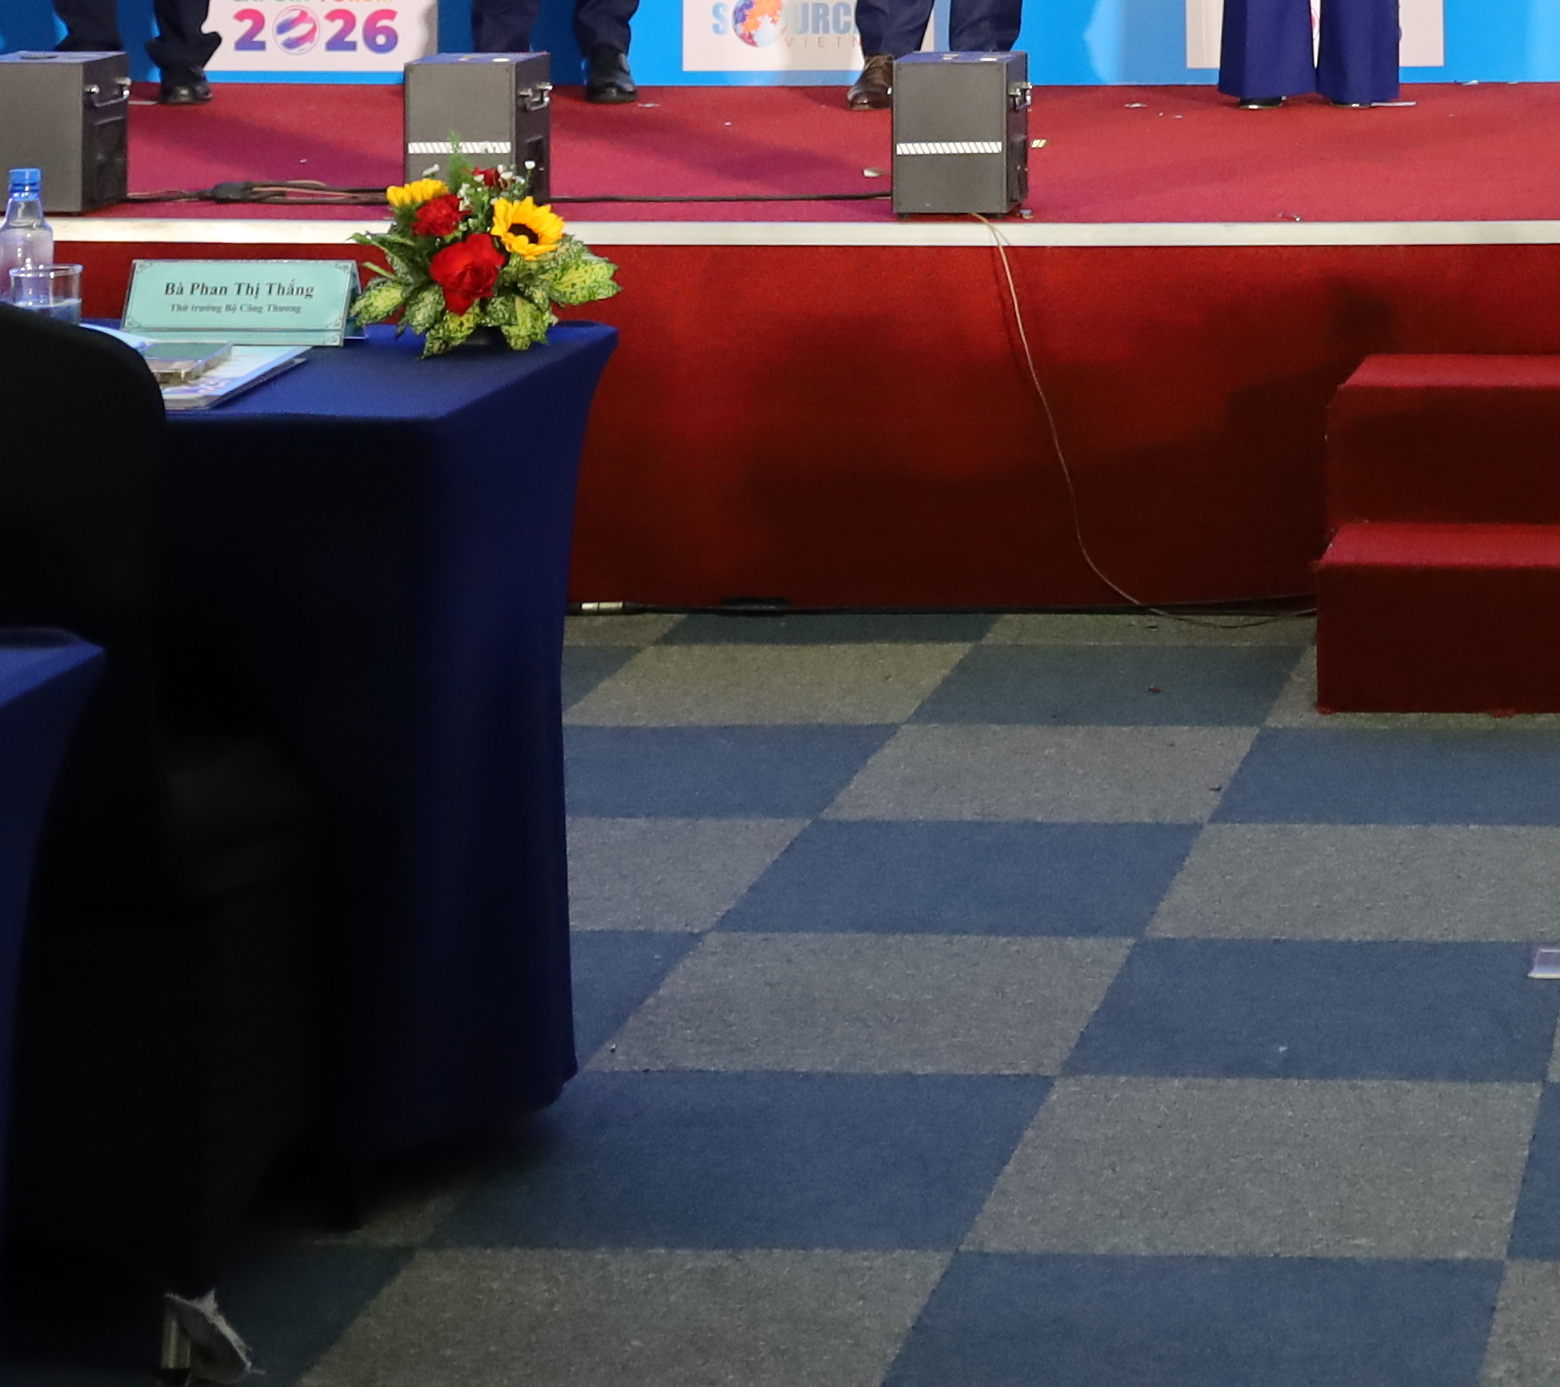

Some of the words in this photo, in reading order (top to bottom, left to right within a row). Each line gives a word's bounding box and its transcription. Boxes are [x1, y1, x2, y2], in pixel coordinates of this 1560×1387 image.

[784, 37, 861, 49] VIETN
[163, 280, 184, 296] Bà
[189, 282, 228, 296] Phan
[234, 282, 261, 299] Thị
[265, 278, 315, 300] Thắng
